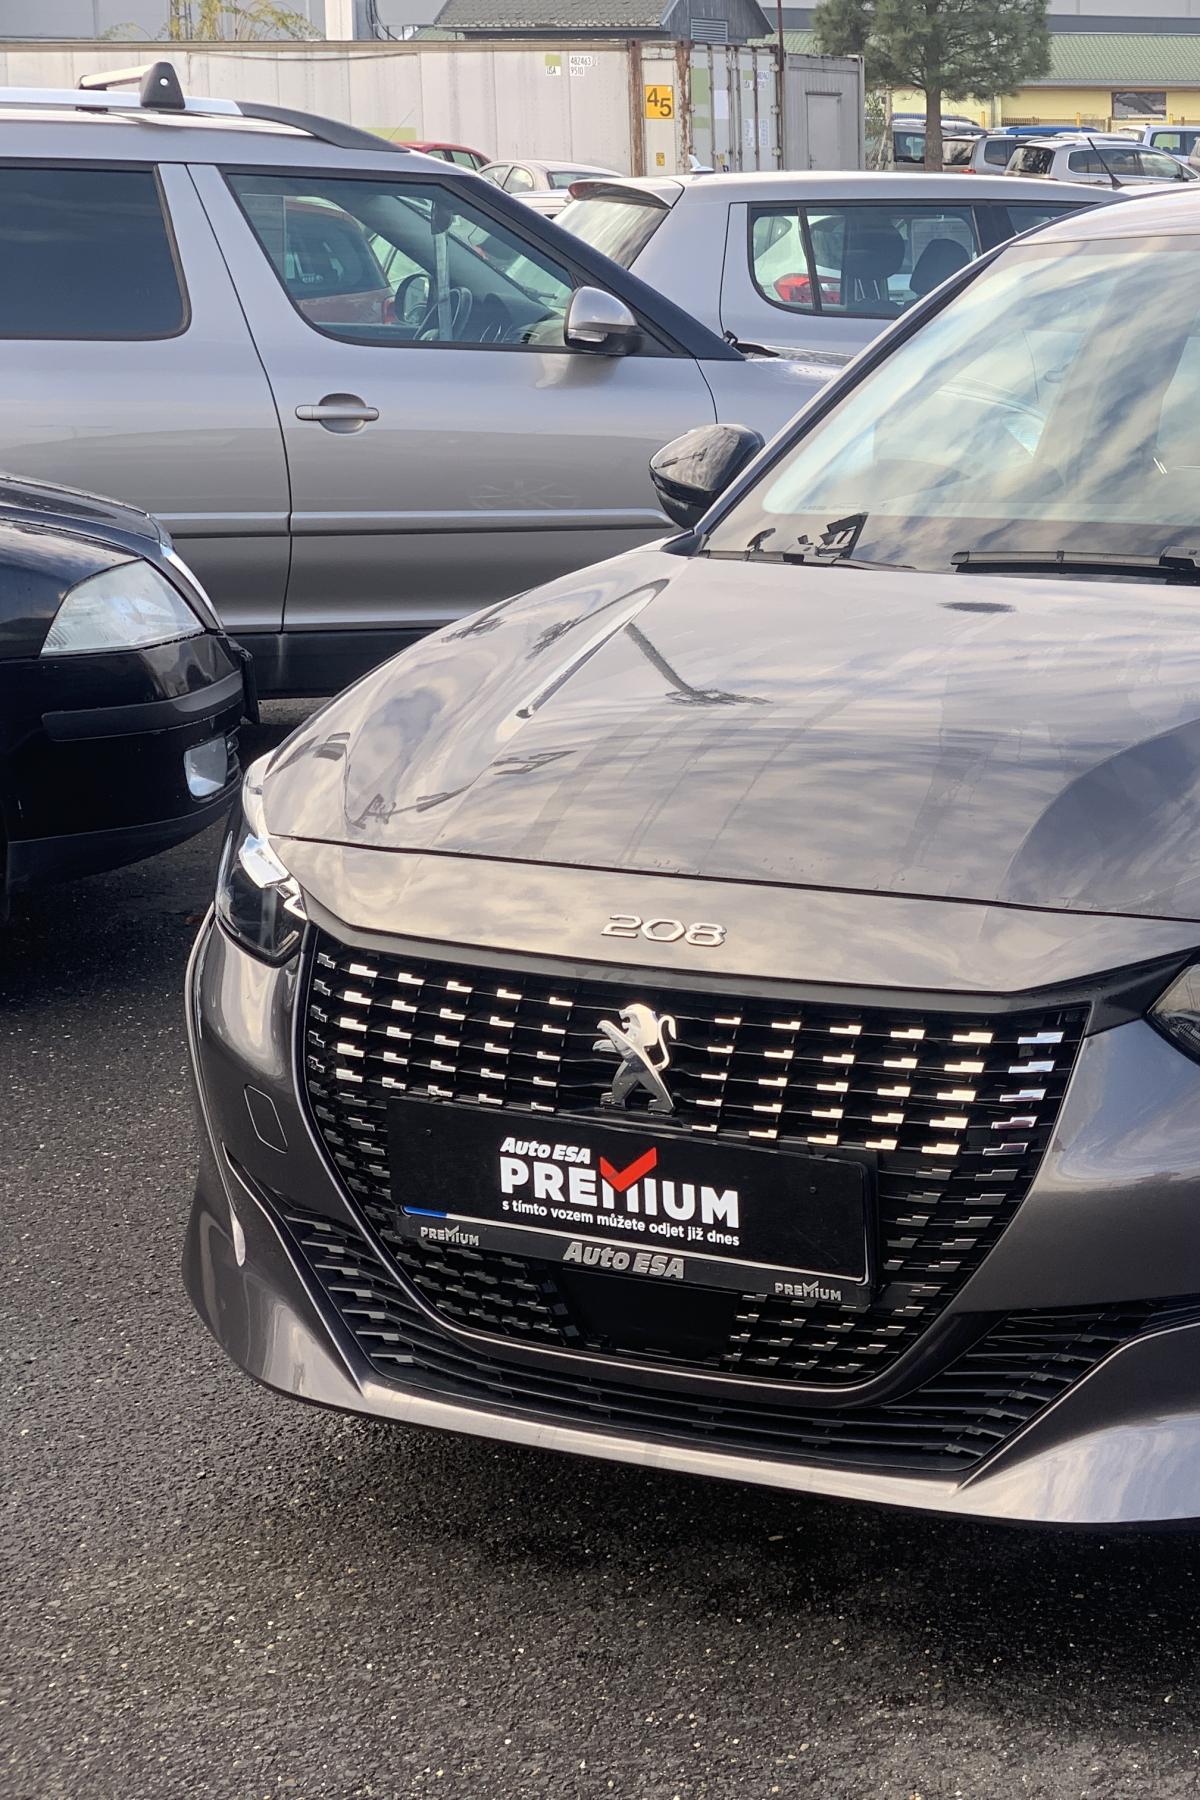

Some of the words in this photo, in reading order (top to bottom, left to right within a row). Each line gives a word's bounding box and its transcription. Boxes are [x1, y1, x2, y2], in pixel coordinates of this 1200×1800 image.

[646, 87, 673, 117] 45
[600, 914, 727, 947] 208
[500, 1137, 549, 1158] Auto
[552, 1144, 591, 1164] ESA
[500, 1147, 740, 1228] PREMIUM
[420, 1225, 479, 1246] PREMIUM
[502, 1202, 509, 1211] s
[512, 1200, 547, 1216] tímto
[551, 1208, 594, 1224] vozem
[597, 1212, 645, 1231] můžete
[649, 1222, 684, 1238] odjet
[687, 1225, 704, 1241] již
[707, 1230, 740, 1246] dnes
[563, 1241, 631, 1270] Auto
[633, 1252, 685, 1279] ESA
[774, 1281, 842, 1301] PREMIUM
